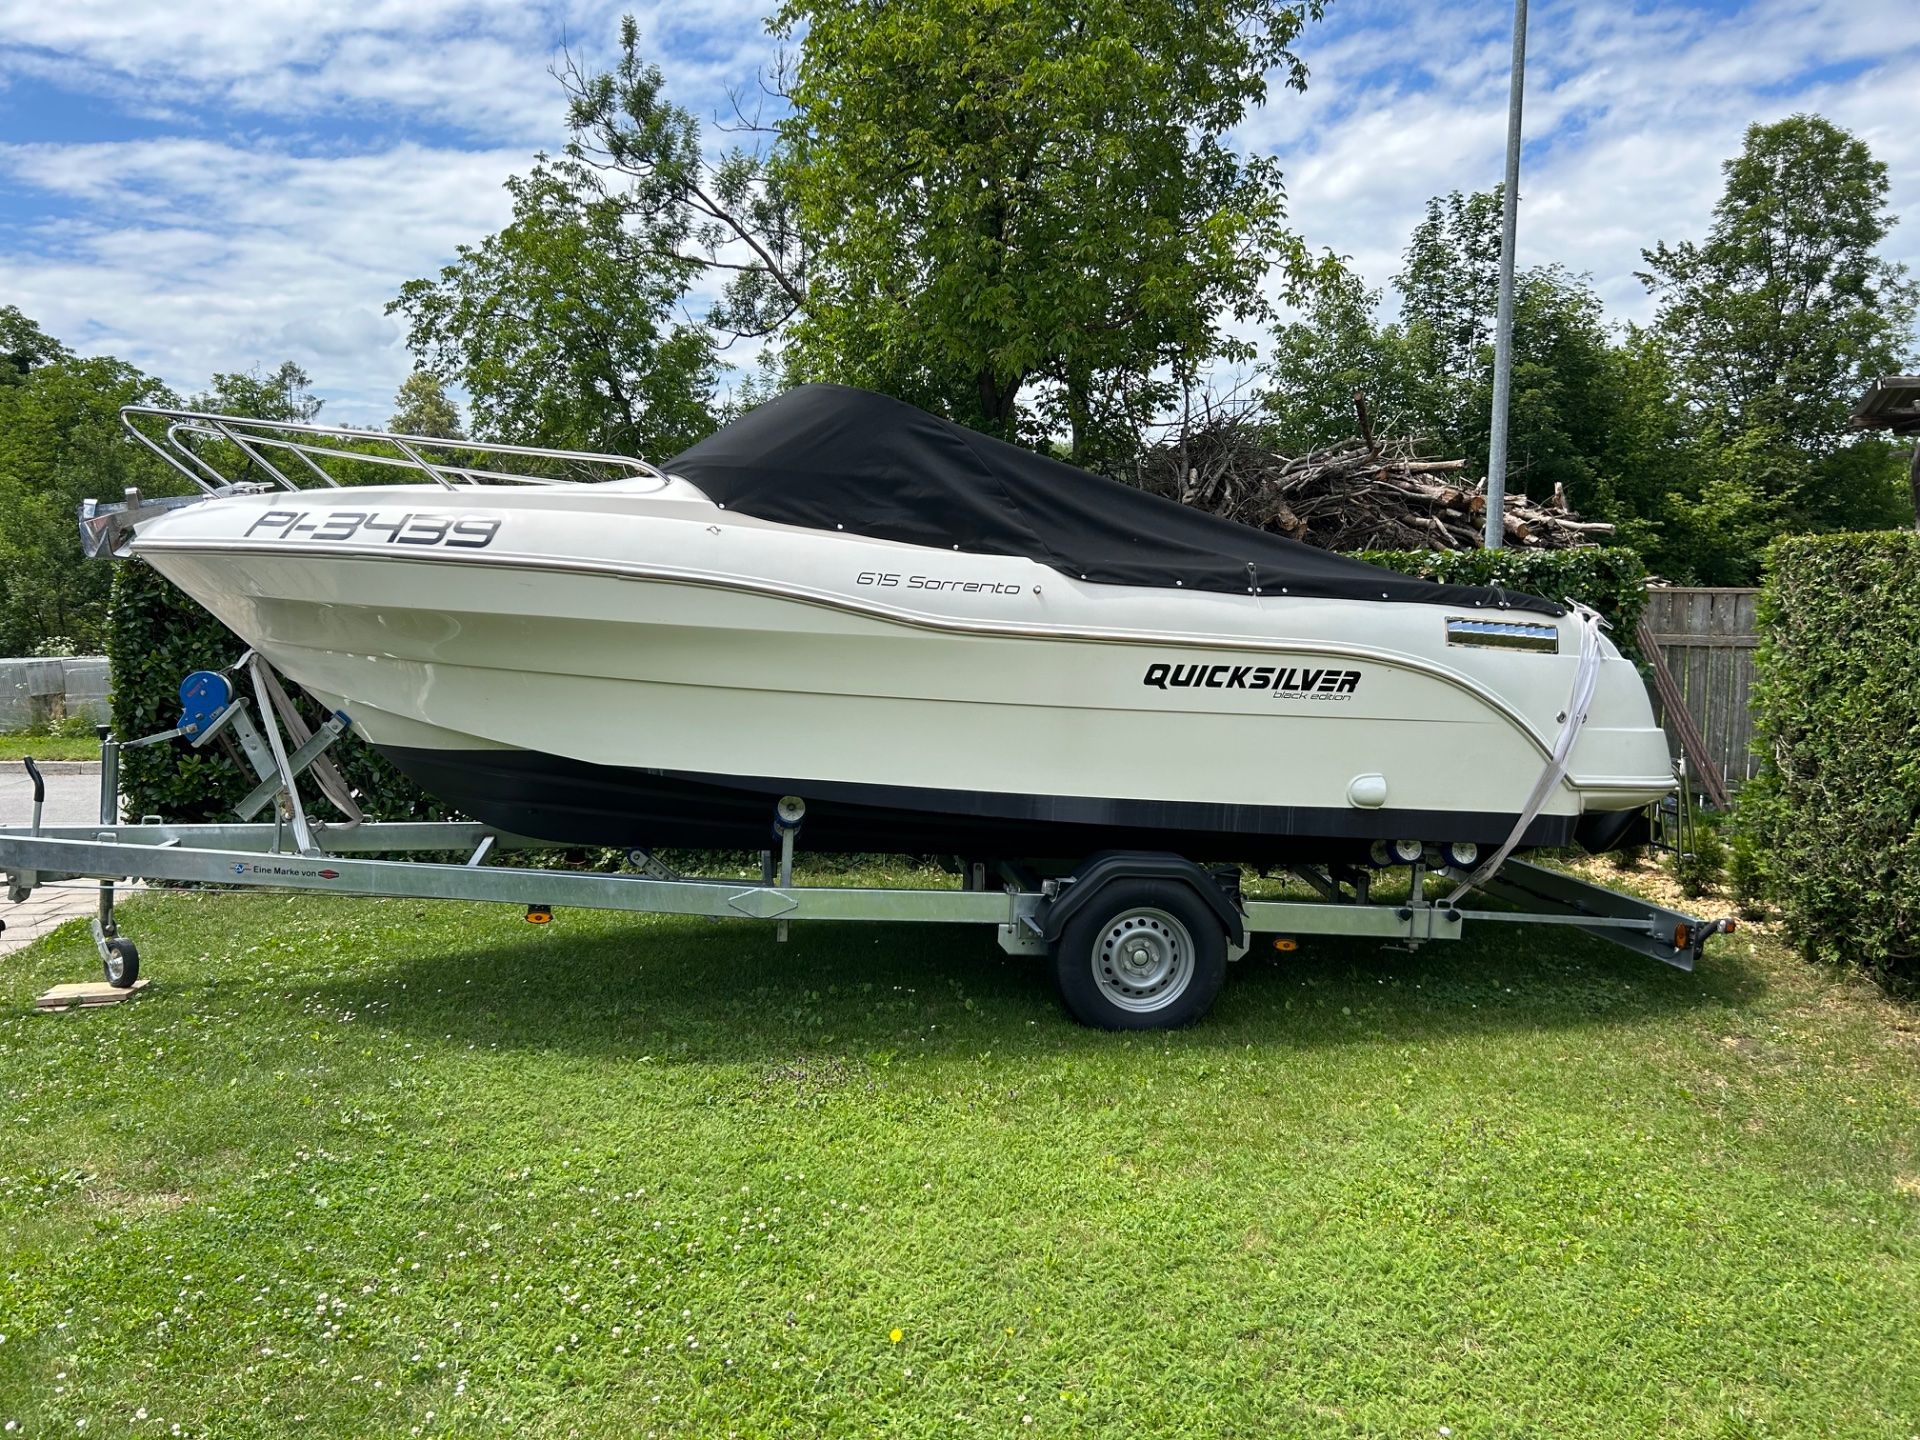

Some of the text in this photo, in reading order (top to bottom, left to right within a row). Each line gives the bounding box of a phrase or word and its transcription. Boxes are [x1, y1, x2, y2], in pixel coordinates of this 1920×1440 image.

[243, 511, 502, 548] PI-3439
[856, 572, 1021, 595] 615 Sorrento
[1143, 663, 1362, 693] QUICKSILVER
[1273, 690, 1352, 701] black edition
[253, 865, 272, 874] Eine
[274, 867, 299, 877] Marke
